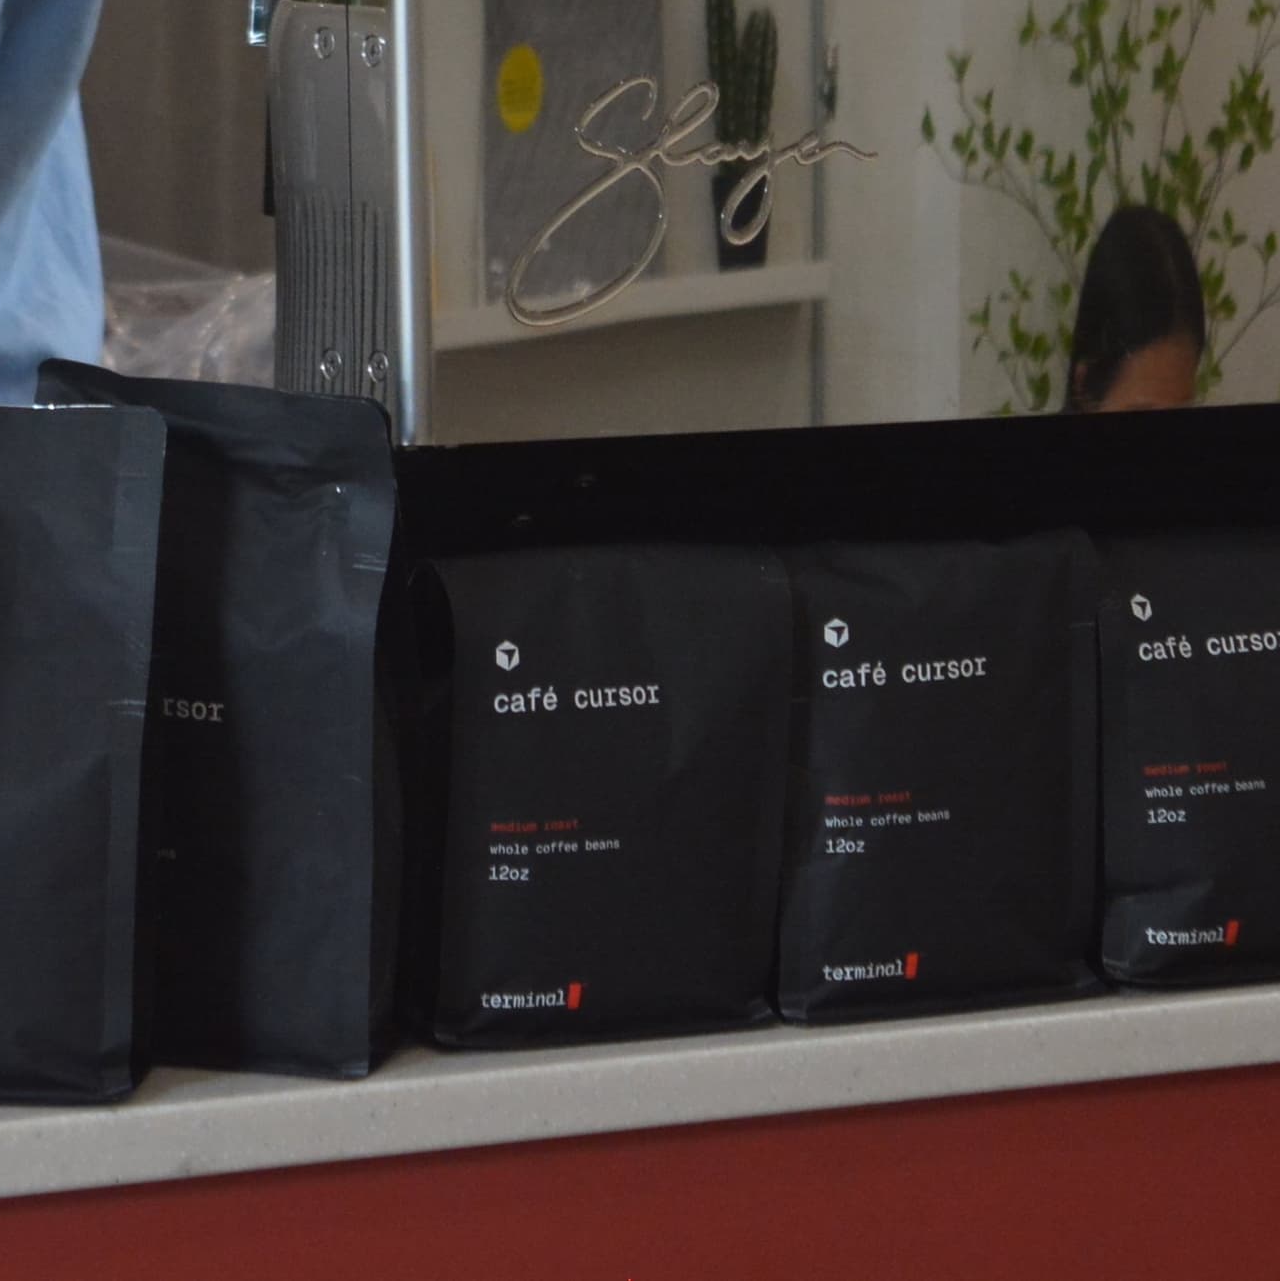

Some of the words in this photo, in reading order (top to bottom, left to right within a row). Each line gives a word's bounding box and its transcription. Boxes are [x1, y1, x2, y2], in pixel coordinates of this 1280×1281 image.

[1138, 635, 1192, 662] café
[822, 662, 887, 689] café
[901, 657, 987, 683] cursor
[493, 686, 558, 714] café
[574, 685, 660, 709] cursor
[1145, 785, 1183, 798] whole
[1189, 782, 1230, 796] coffee
[824, 816, 863, 828] whole
[870, 813, 912, 827] coffee
[917, 810, 950, 823] beans
[1147, 808, 1186, 824] 12oz
[489, 843, 529, 855] whole
[535, 840, 579, 854] coffee
[585, 839, 620, 851] beans
[826, 838, 865, 854] 12oz
[489, 865, 529, 881] 12oz
[1145, 927, 1223, 945] terminal
[822, 959, 903, 981] terminal
[481, 989, 565, 1009] terminal
